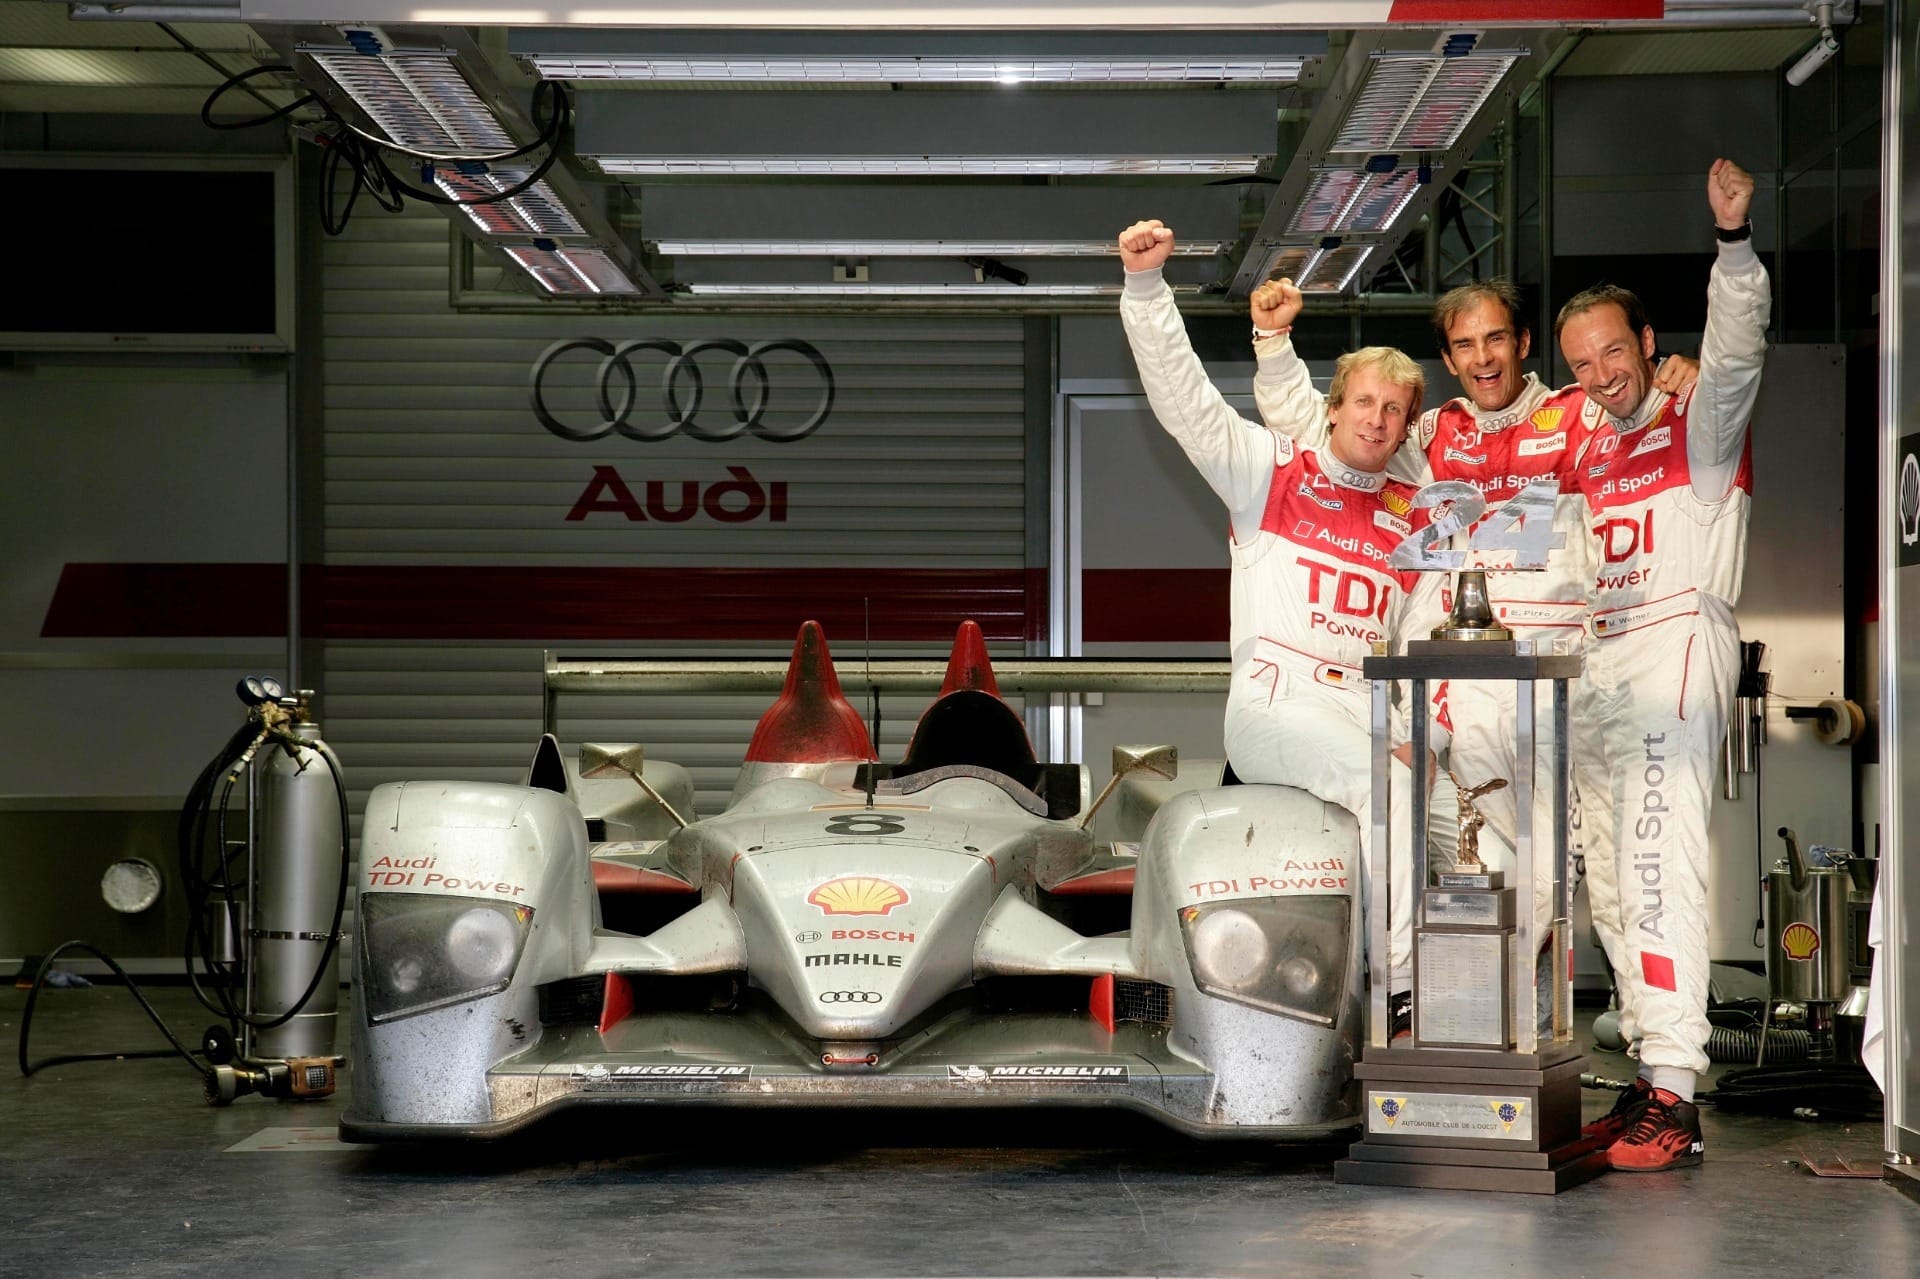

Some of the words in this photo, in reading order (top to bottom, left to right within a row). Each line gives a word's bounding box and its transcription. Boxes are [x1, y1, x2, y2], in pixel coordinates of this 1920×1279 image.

[1536, 437, 1564, 450] BOSCH
[1641, 432, 1670, 447] BOSCH
[1470, 477, 1502, 492] Audi
[1619, 467, 1664, 492] Sport
[564, 465, 788, 523] Audi
[1316, 527, 1359, 552] Audi
[1361, 542, 1391, 563] Spo
[1295, 556, 1391, 626] TDI
[1635, 732, 1669, 841] Sport
[824, 813, 905, 835] 8
[372, 856, 438, 869] Audi
[1283, 858, 1344, 872] Audi
[367, 871, 414, 886] TDI
[423, 873, 526, 897] Power
[1189, 879, 1239, 898] TDI
[1249, 875, 1349, 892] Power
[1634, 852, 1664, 940] Audi
[831, 929, 915, 943] BOSCH
[805, 953, 903, 967] MAHLE
[615, 1066, 747, 1075] MICHELIN
[992, 1066, 1122, 1076] MICHELIN
[1401, 1120, 1441, 1129] AUTOMOBILE
[1442, 1122, 1460, 1130] CLUB
[1690, 1141, 1705, 1154] FIL
